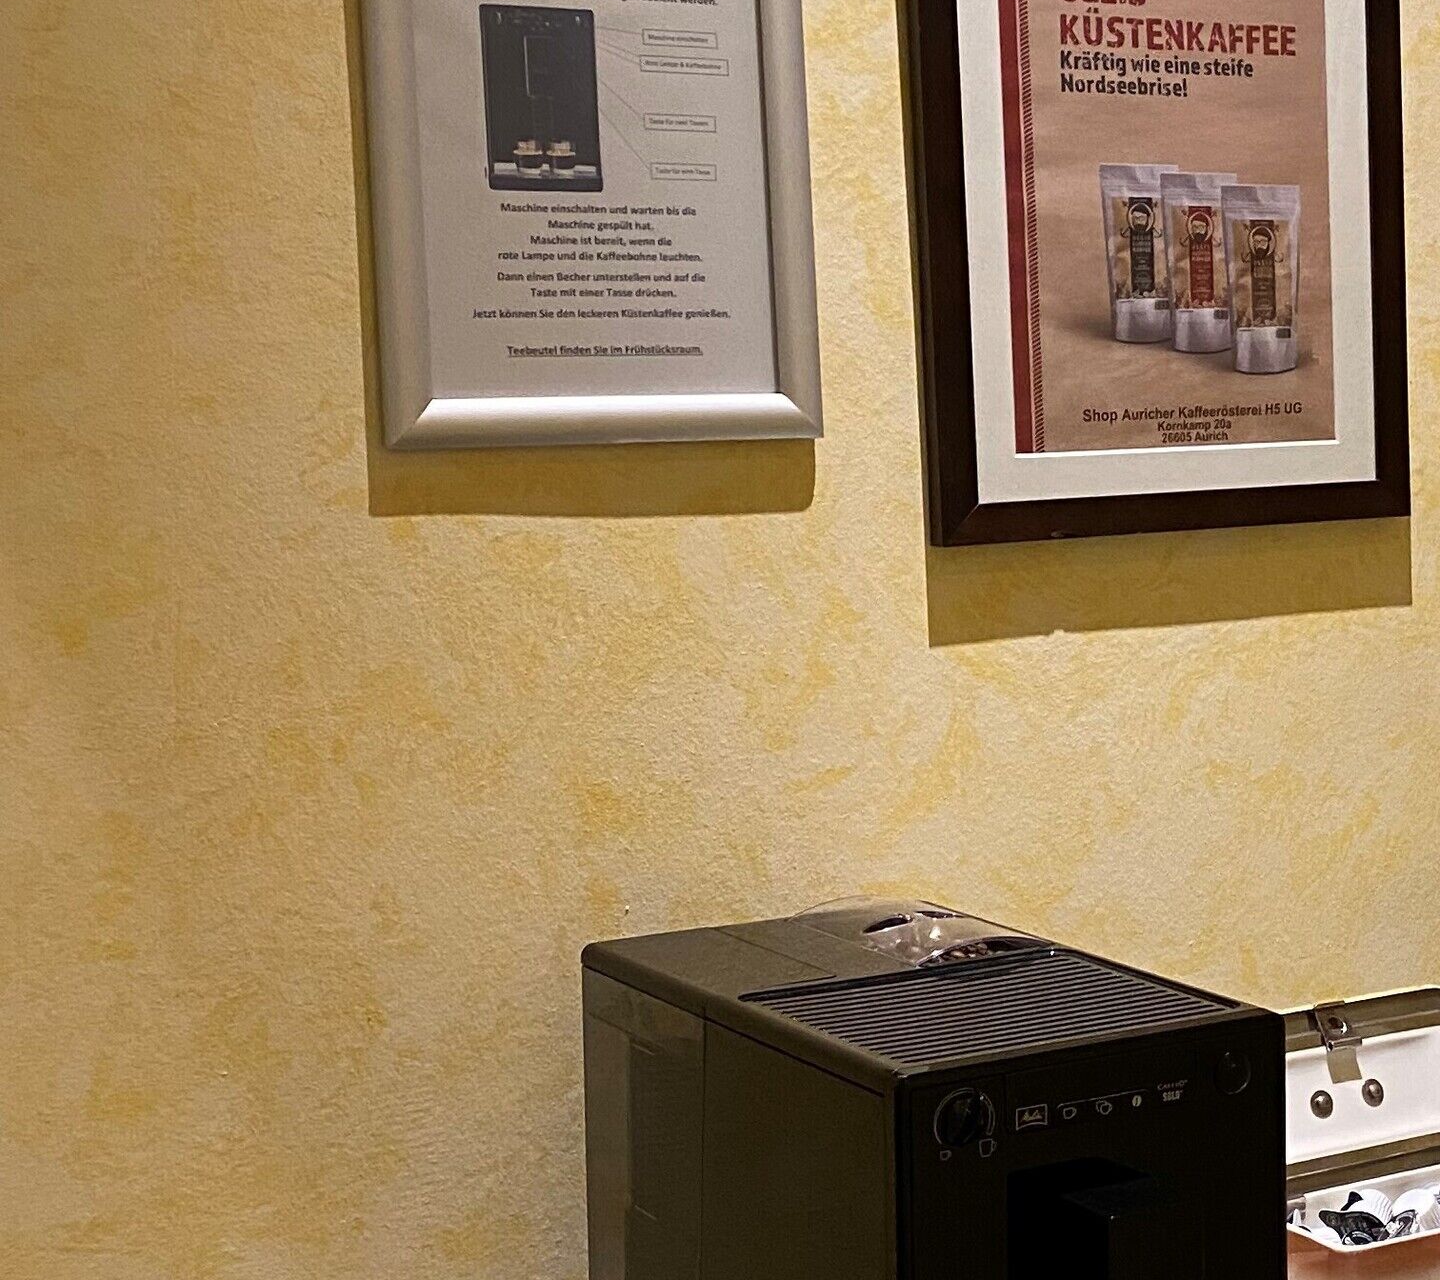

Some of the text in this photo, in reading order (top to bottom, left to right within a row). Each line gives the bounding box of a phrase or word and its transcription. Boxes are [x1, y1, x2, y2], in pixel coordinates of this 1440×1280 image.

[1059, 7, 1297, 56] KÜSTENKAFFEE
[1060, 50, 1254, 77] Kräftig wie eine steife
[1060, 72, 1188, 97] Nordseebrise!
[500, 203, 696, 216] Maschine einschalten und warten bis die
[548, 220, 595, 230] Maschine
[597, 220, 633, 232] gespült
[530, 235, 578, 245] Maschine
[580, 235, 592, 245] ist
[629, 238, 655, 246] wenn
[657, 237, 672, 246] die
[498, 252, 519, 260] rote
[522, 252, 554, 262] Lampe
[557, 251, 576, 261] und
[579, 251, 594, 261] die
[597, 251, 657, 261] Kaffeebohne
[497, 272, 705, 282] Dann einen Becher unterstellen und auf die
[531, 288, 558, 297] Taste
[560, 288, 576, 297] mit
[579, 288, 604, 297] einer
[606, 288, 633, 297] Tasse
[472, 309, 497, 319] Jetzt
[499, 309, 538, 318] können
[539, 309, 554, 318] Sie
[557, 309, 575, 318] den
[578, 309, 619, 318] leckeren
[621, 309, 683, 319] Küstenkaffee
[507, 345, 557, 356] Teebeutel
[559, 345, 592, 356] finden
[593, 345, 608, 356] Sie
[610, 345, 623, 356] im
[1082, 408, 1118, 425] Shop
[1122, 406, 1176, 421] Auricher
[1178, 404, 1262, 419] Kaffeerösterei
[1284, 402, 1302, 414] UG
[1157, 419, 1232, 432] Kornkamp 20a
[1194, 430, 1229, 442] Aurich
